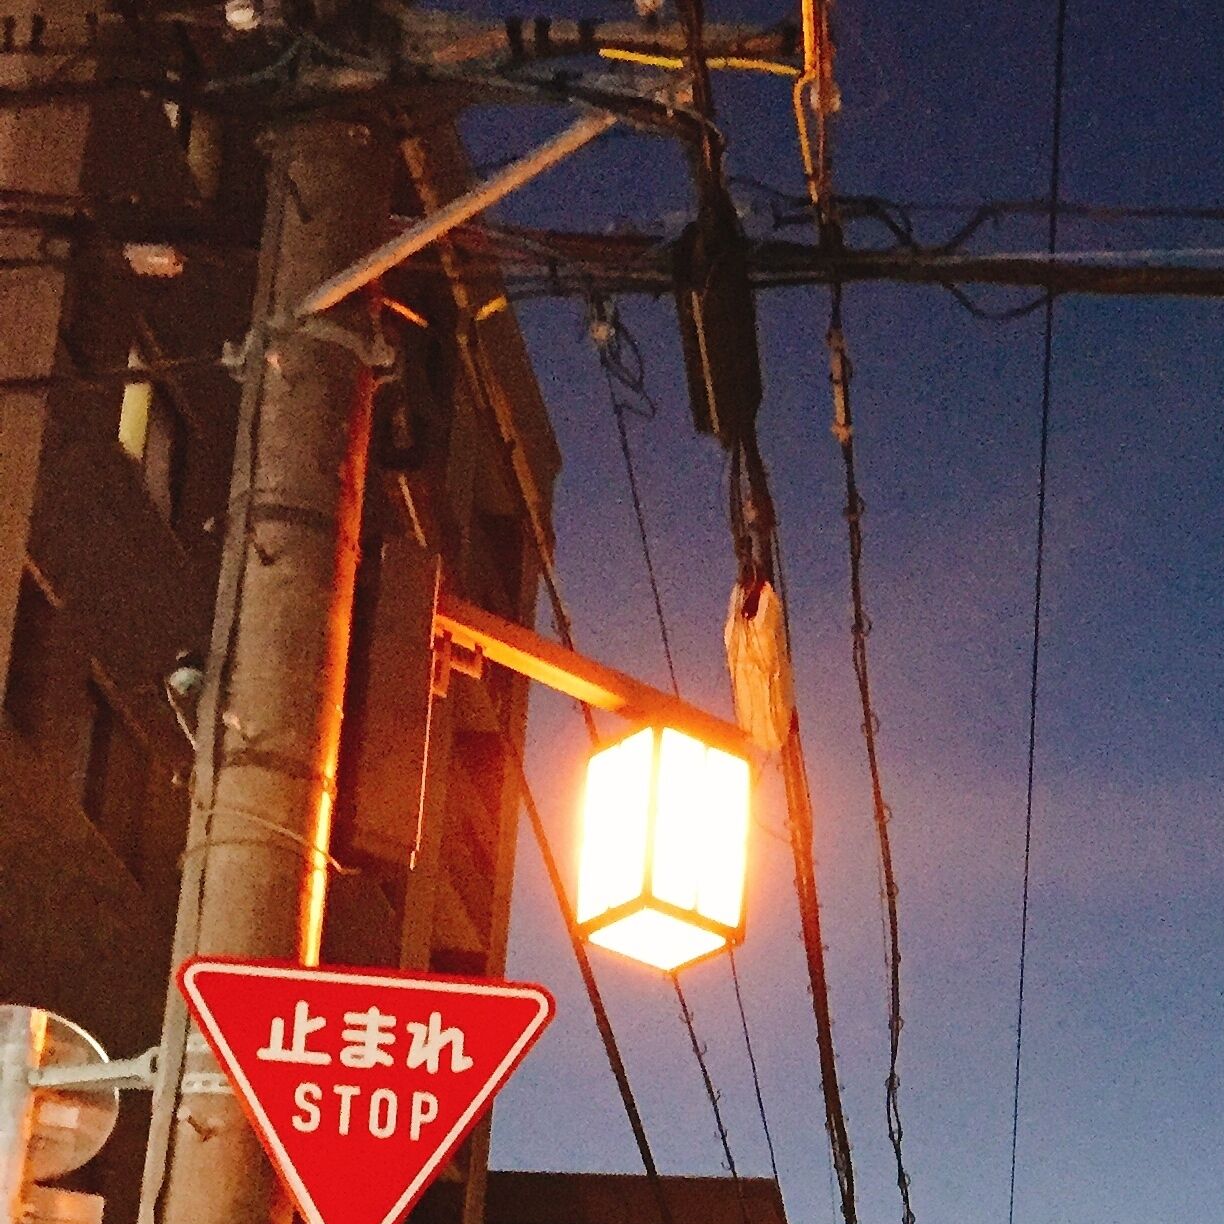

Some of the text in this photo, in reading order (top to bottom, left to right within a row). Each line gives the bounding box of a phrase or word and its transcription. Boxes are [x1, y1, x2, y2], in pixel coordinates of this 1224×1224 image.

[256, 1000, 474, 1074] 止まれ
[291, 1082, 439, 1141] STOP
